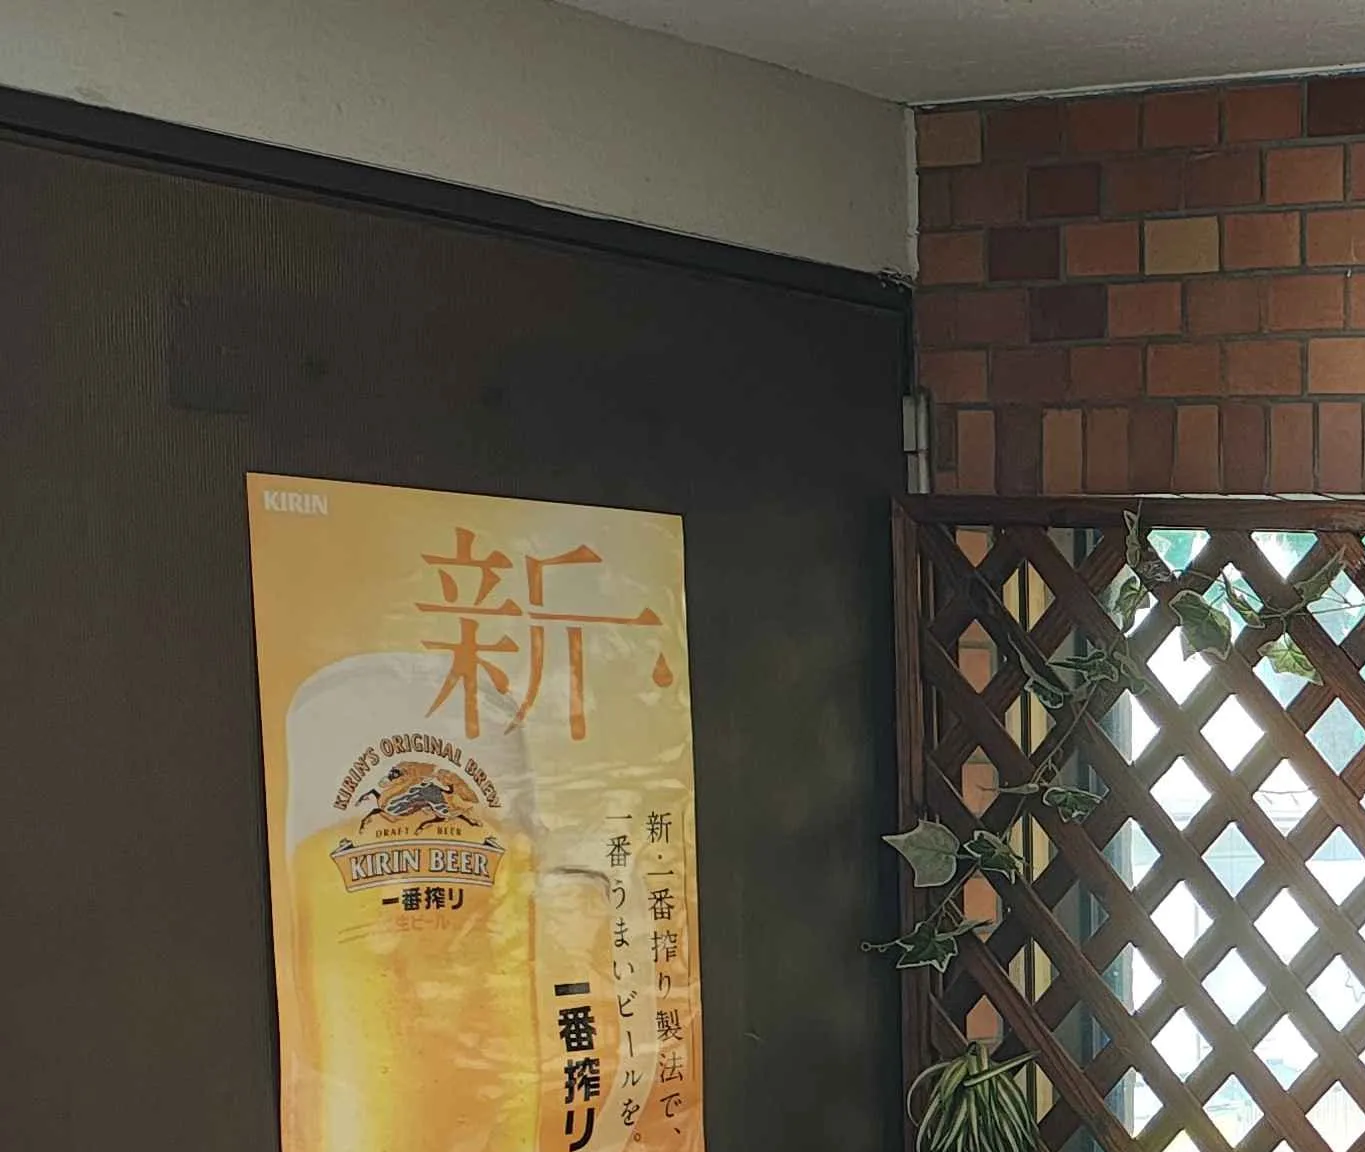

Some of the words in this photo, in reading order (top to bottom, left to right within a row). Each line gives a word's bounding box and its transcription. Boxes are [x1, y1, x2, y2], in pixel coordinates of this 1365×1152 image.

[264, 490, 328, 515] KIRIN
[414, 526, 664, 741] 新
[332, 748, 381, 811] KIRIN'S
[380, 733, 463, 768] ORIGINAL
[463, 758, 503, 810] BREW
[375, 827, 410, 838] DRAFT
[437, 826, 463, 837] BEER
[350, 848, 422, 881] KIRIN
[429, 848, 489, 878] BEER
[381, 887, 465, 912] 一番搾り
[554, 981, 601, 1152] 一番搾り
